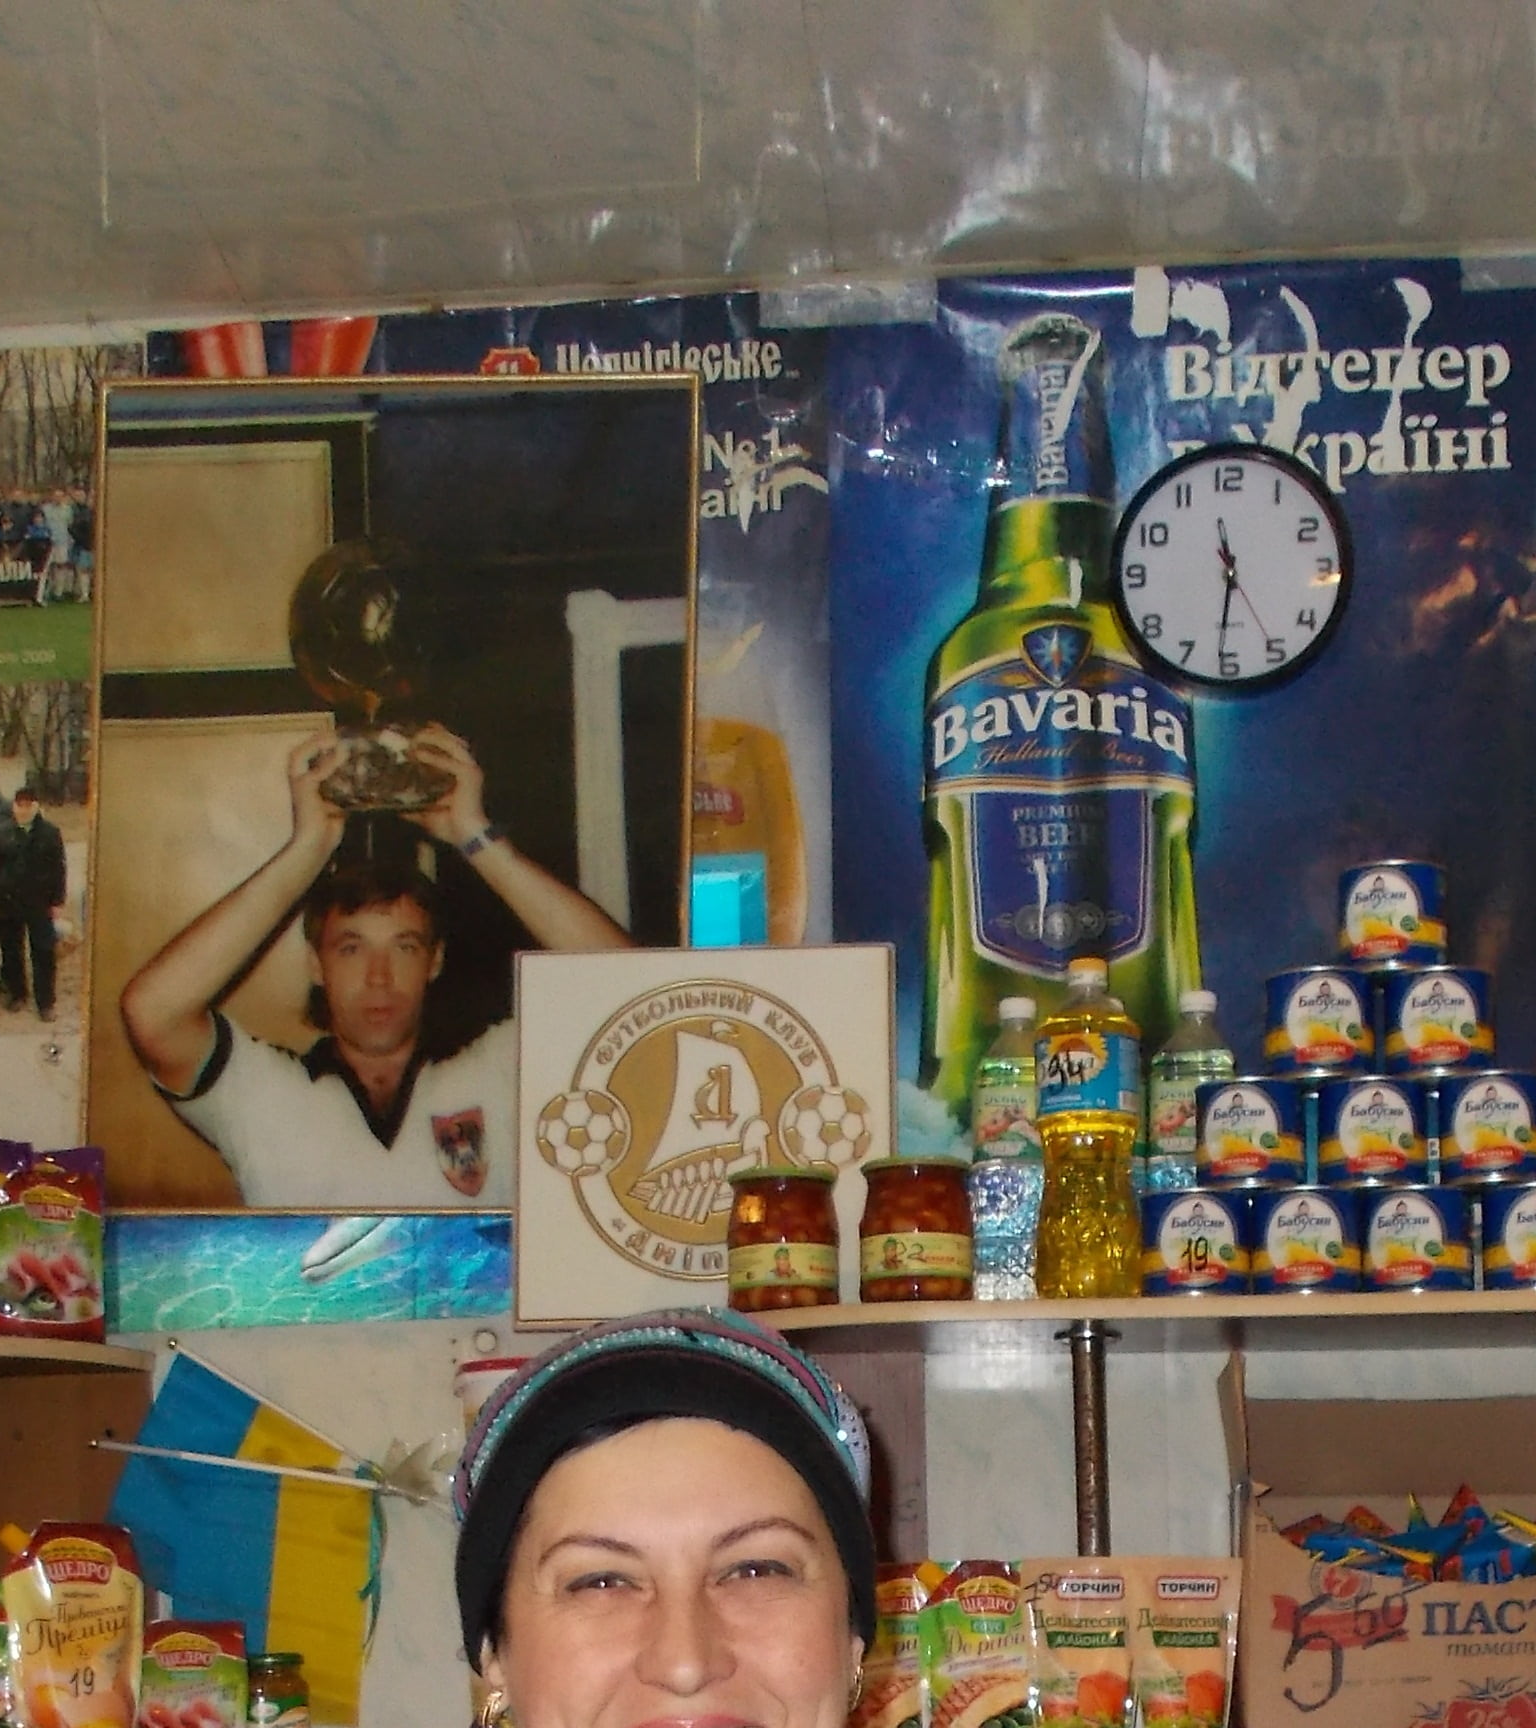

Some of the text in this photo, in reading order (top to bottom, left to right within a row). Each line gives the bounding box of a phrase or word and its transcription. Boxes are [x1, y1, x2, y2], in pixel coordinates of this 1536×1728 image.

[1167, 341, 1512, 407] Відтепер
[1214, 466, 1244, 492] 12
[1274, 479, 1281, 505] 1
[1175, 483, 1192, 509] 11
[1140, 522, 1169, 548] 10
[1297, 517, 1319, 543] 2
[1125, 564, 1147, 589] 9
[1142, 614, 1162, 639] 8
[1296, 608, 1315, 631] 4
[1178, 640, 1196, 665] 7
[1265, 638, 1287, 664] 5
[1219, 652, 1240, 678] 6
[932, 685, 1188, 770] Bavaria
[595, 988, 821, 1069] ФУТБОЛЬНИЙ КЛУБ
[610, 1215, 725, 1271] «Дніп
[1180, 1235, 1210, 1272] 19
[48, 1560, 109, 1580] ЩЕДРО
[1061, 1581, 1121, 1595] ТОРЧИН
[1159, 1581, 1216, 1595] ТОРЧИН
[964, 1595, 1016, 1612] ЩЕДРО
[1282, 1592, 1347, 1713] 5
[69, 1668, 96, 1699] 19
